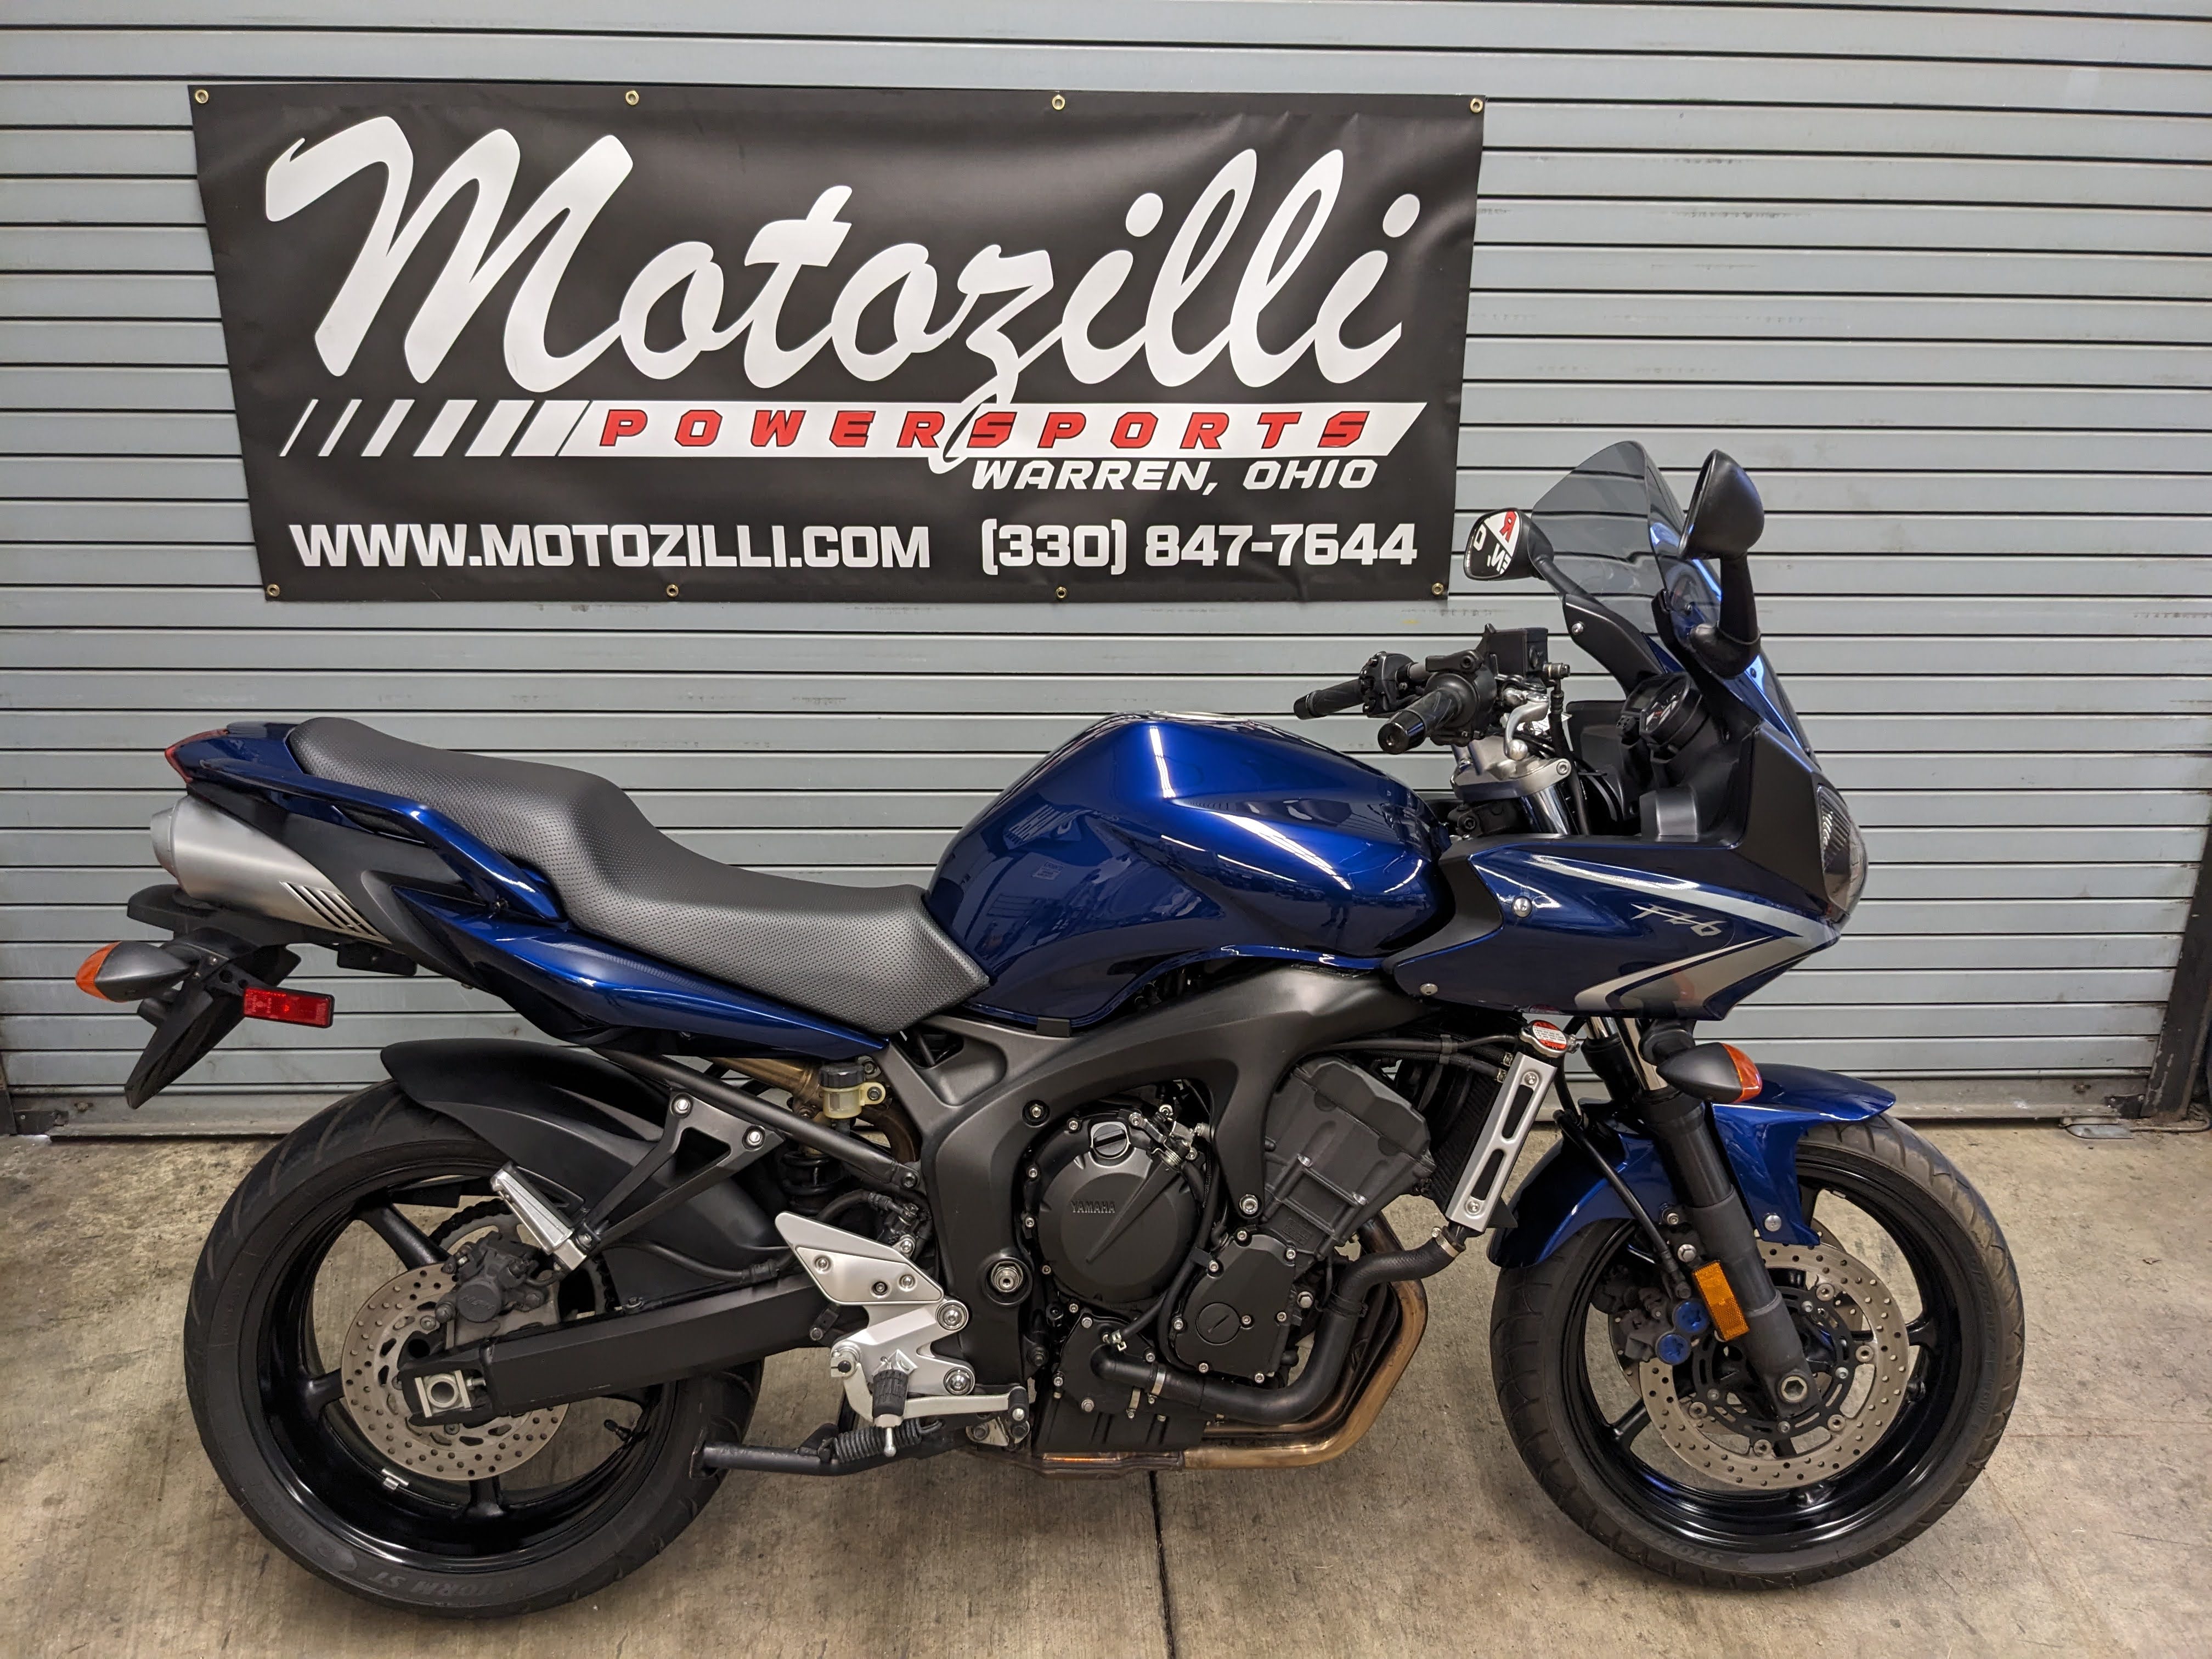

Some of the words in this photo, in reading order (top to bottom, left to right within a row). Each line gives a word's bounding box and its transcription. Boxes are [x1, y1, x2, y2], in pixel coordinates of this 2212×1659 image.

[266, 116, 1420, 474] Motozilli
[599, 409, 1369, 450] POWERSPORTS
[972, 460, 1218, 495] WARREN,
[1243, 459, 1378, 490] OHIO
[289, 523, 930, 568] WWW.MOTOZILLI.COM
[981, 518, 1127, 575] (330)
[1145, 523, 1418, 567] 847-7644
[1070, 1200, 1115, 1214] YAMAHA
